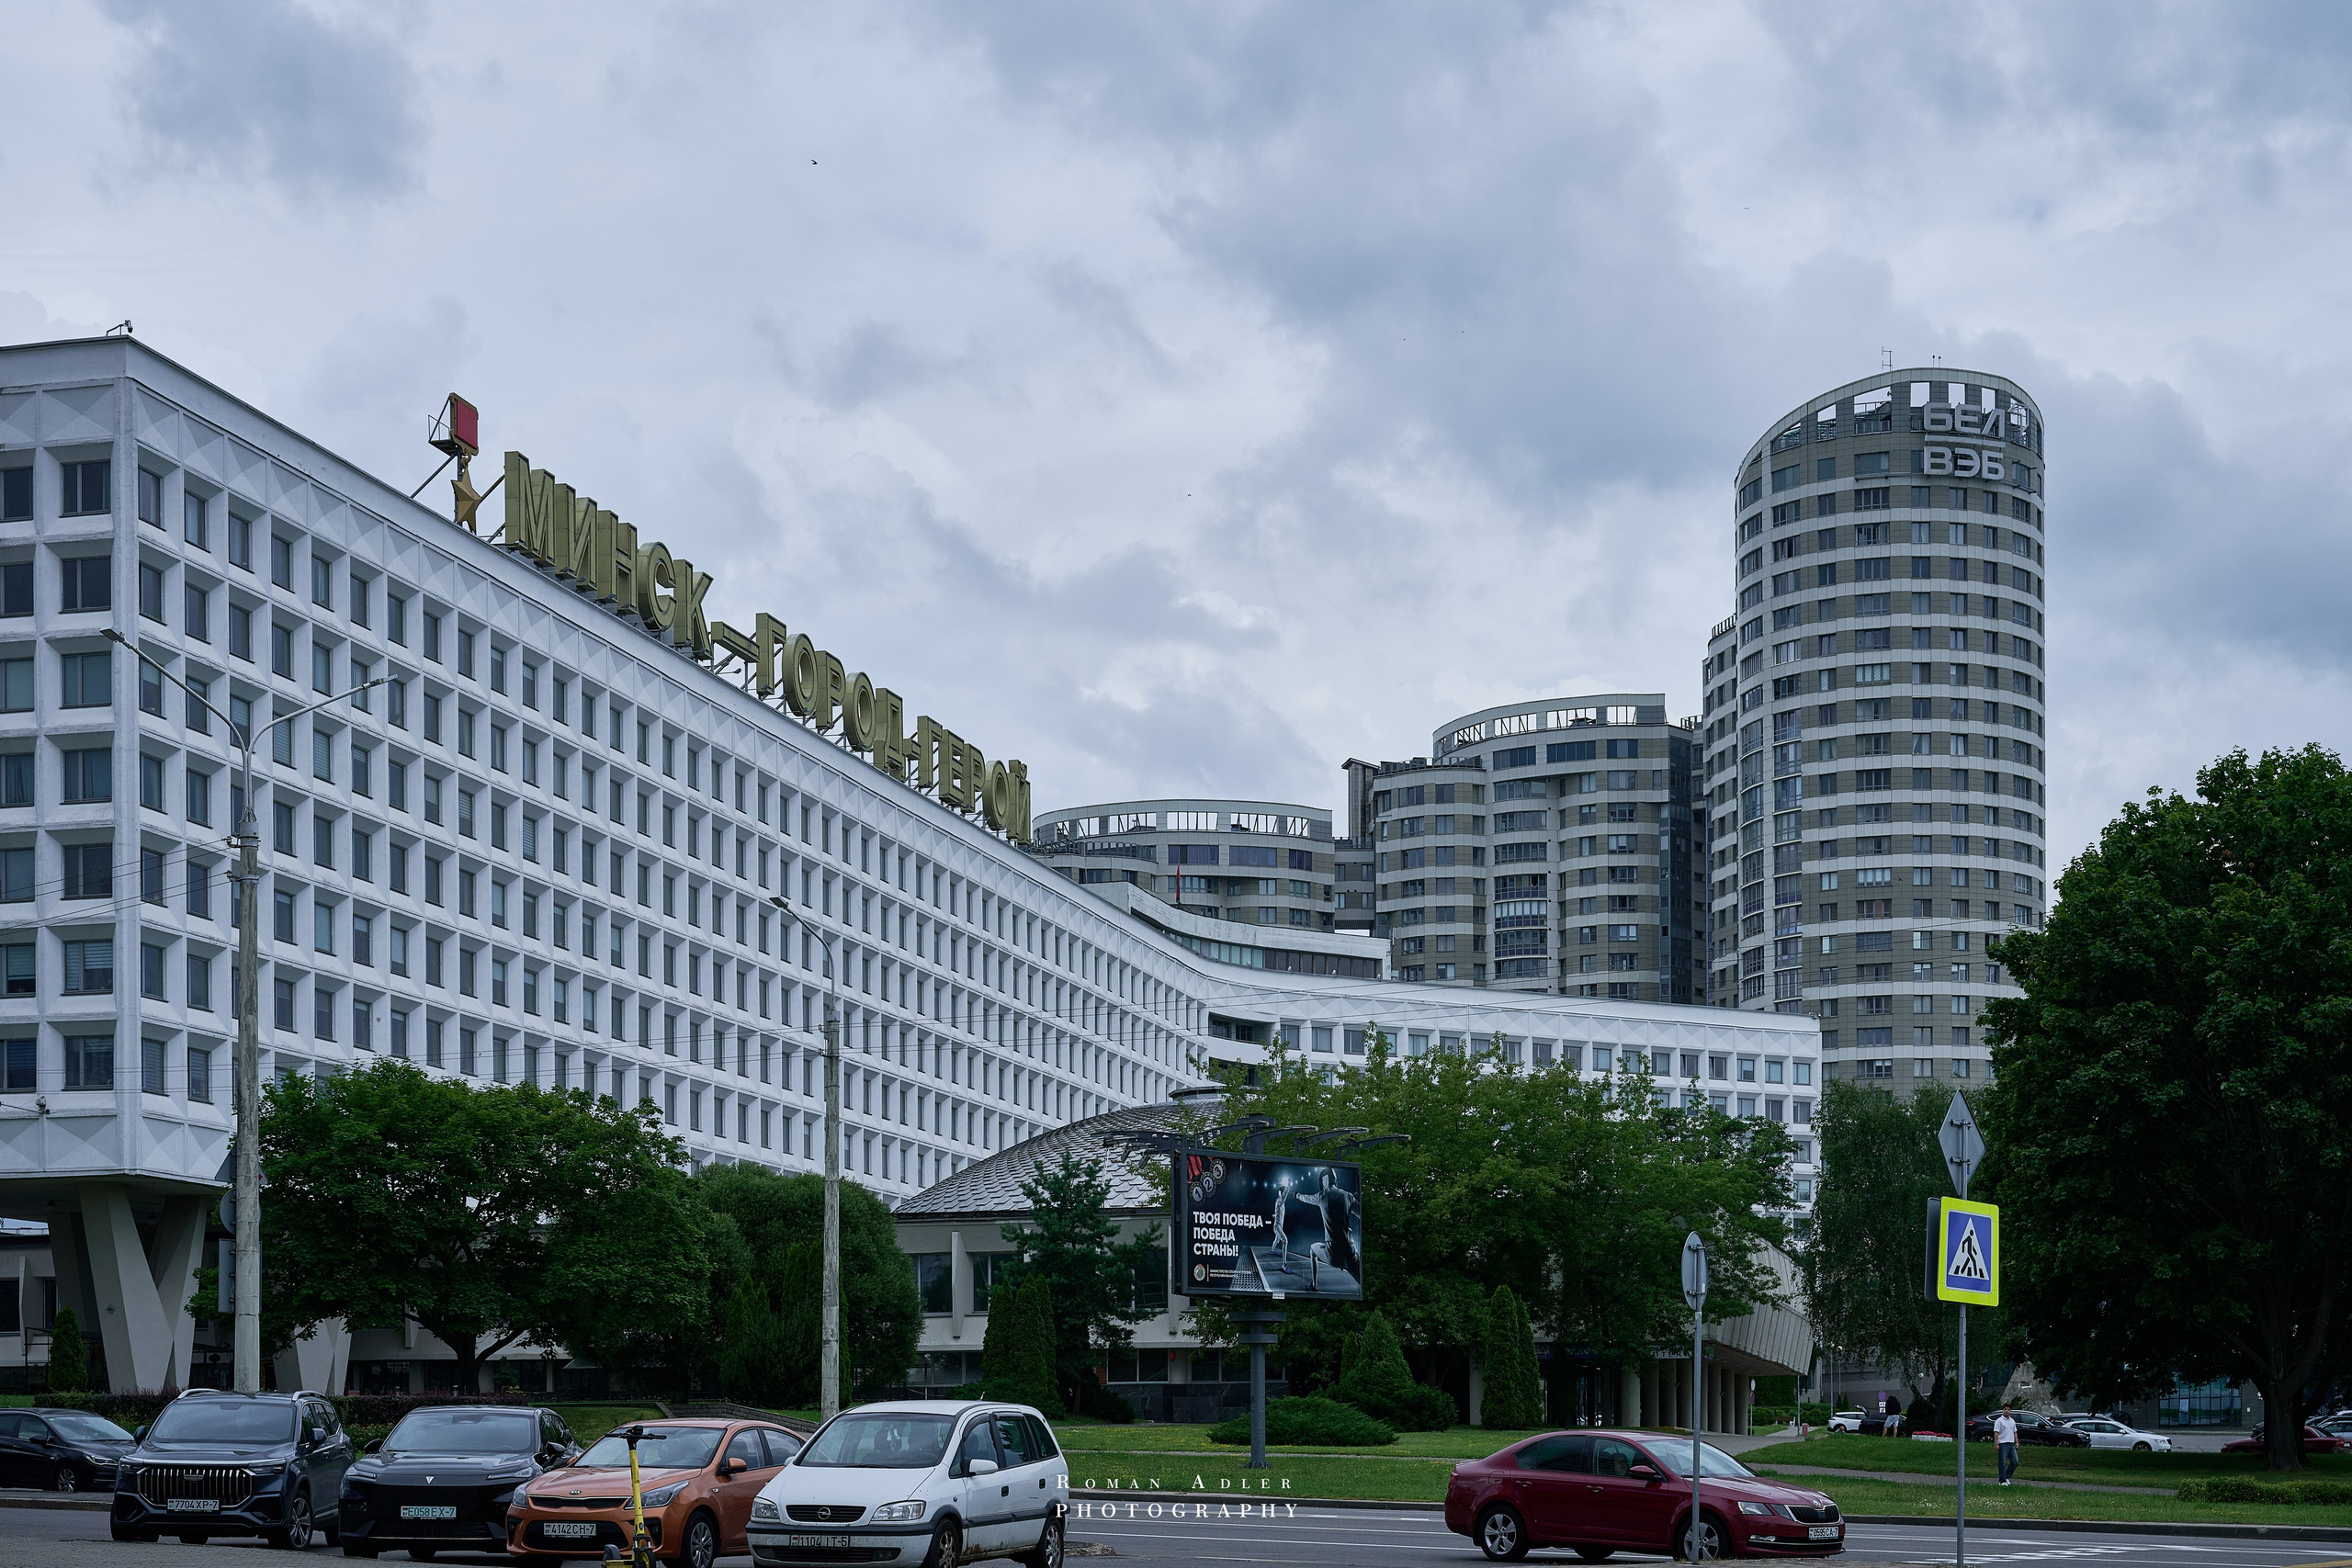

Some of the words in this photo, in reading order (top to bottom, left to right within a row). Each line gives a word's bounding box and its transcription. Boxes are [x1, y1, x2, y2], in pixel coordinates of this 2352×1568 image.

[1923, 401, 2006, 437] БЕЛ
[1923, 446, 2006, 480] ВЭБ
[1215, 1166, 1222, 1177] 3
[1204, 1179, 1213, 1191] 2
[1194, 1188, 1202, 1199] 1
[1193, 1211, 1221, 1225] ТВОЯ
[1223, 1213, 1263, 1229] ПОБЕДА
[1193, 1226, 1236, 1243] ПОБЕДА
[1193, 1242, 1238, 1258] СТРАНЫ!
